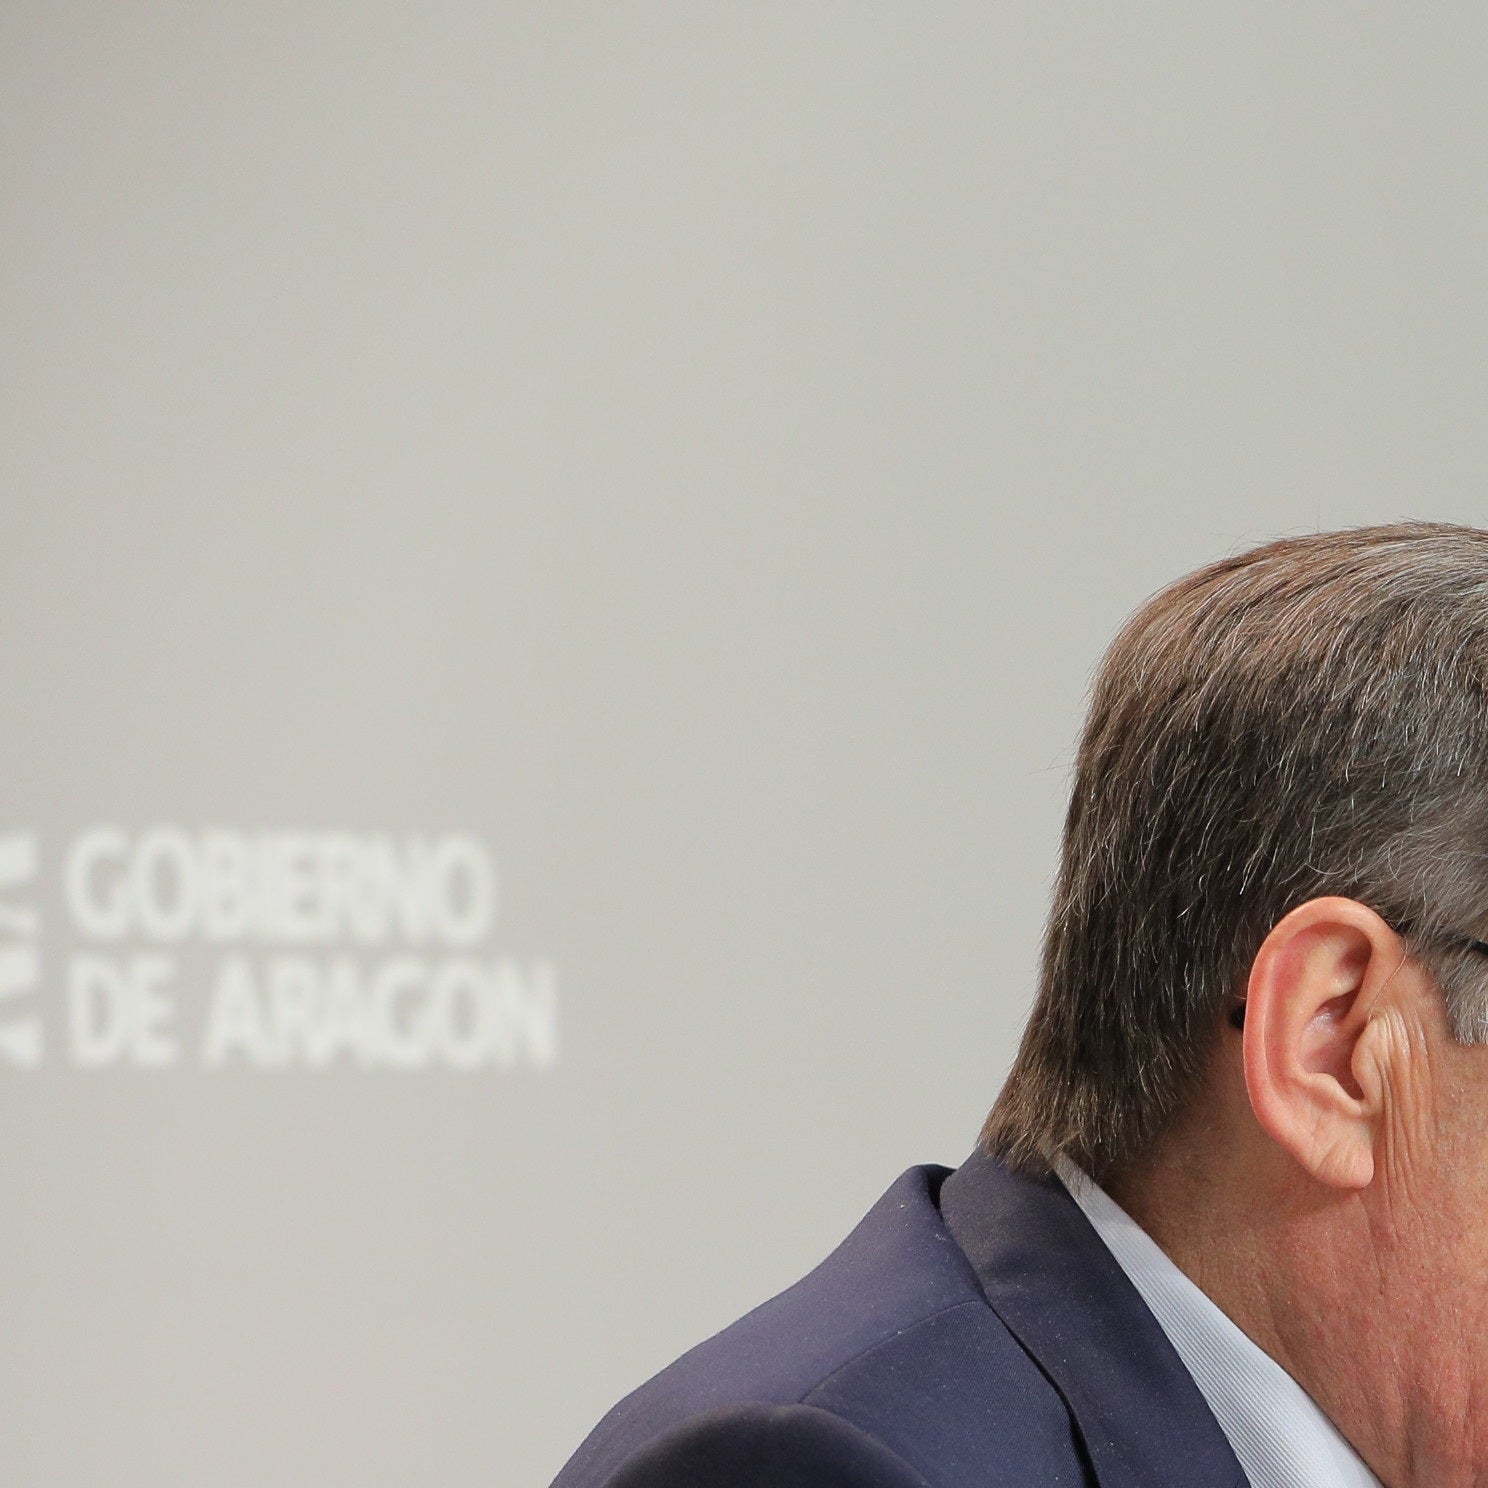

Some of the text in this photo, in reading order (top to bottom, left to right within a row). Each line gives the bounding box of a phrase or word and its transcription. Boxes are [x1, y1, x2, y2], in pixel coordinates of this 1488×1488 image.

[65, 826, 497, 943] GOBIERNO
[70, 957, 558, 1071] DE ARAGON
